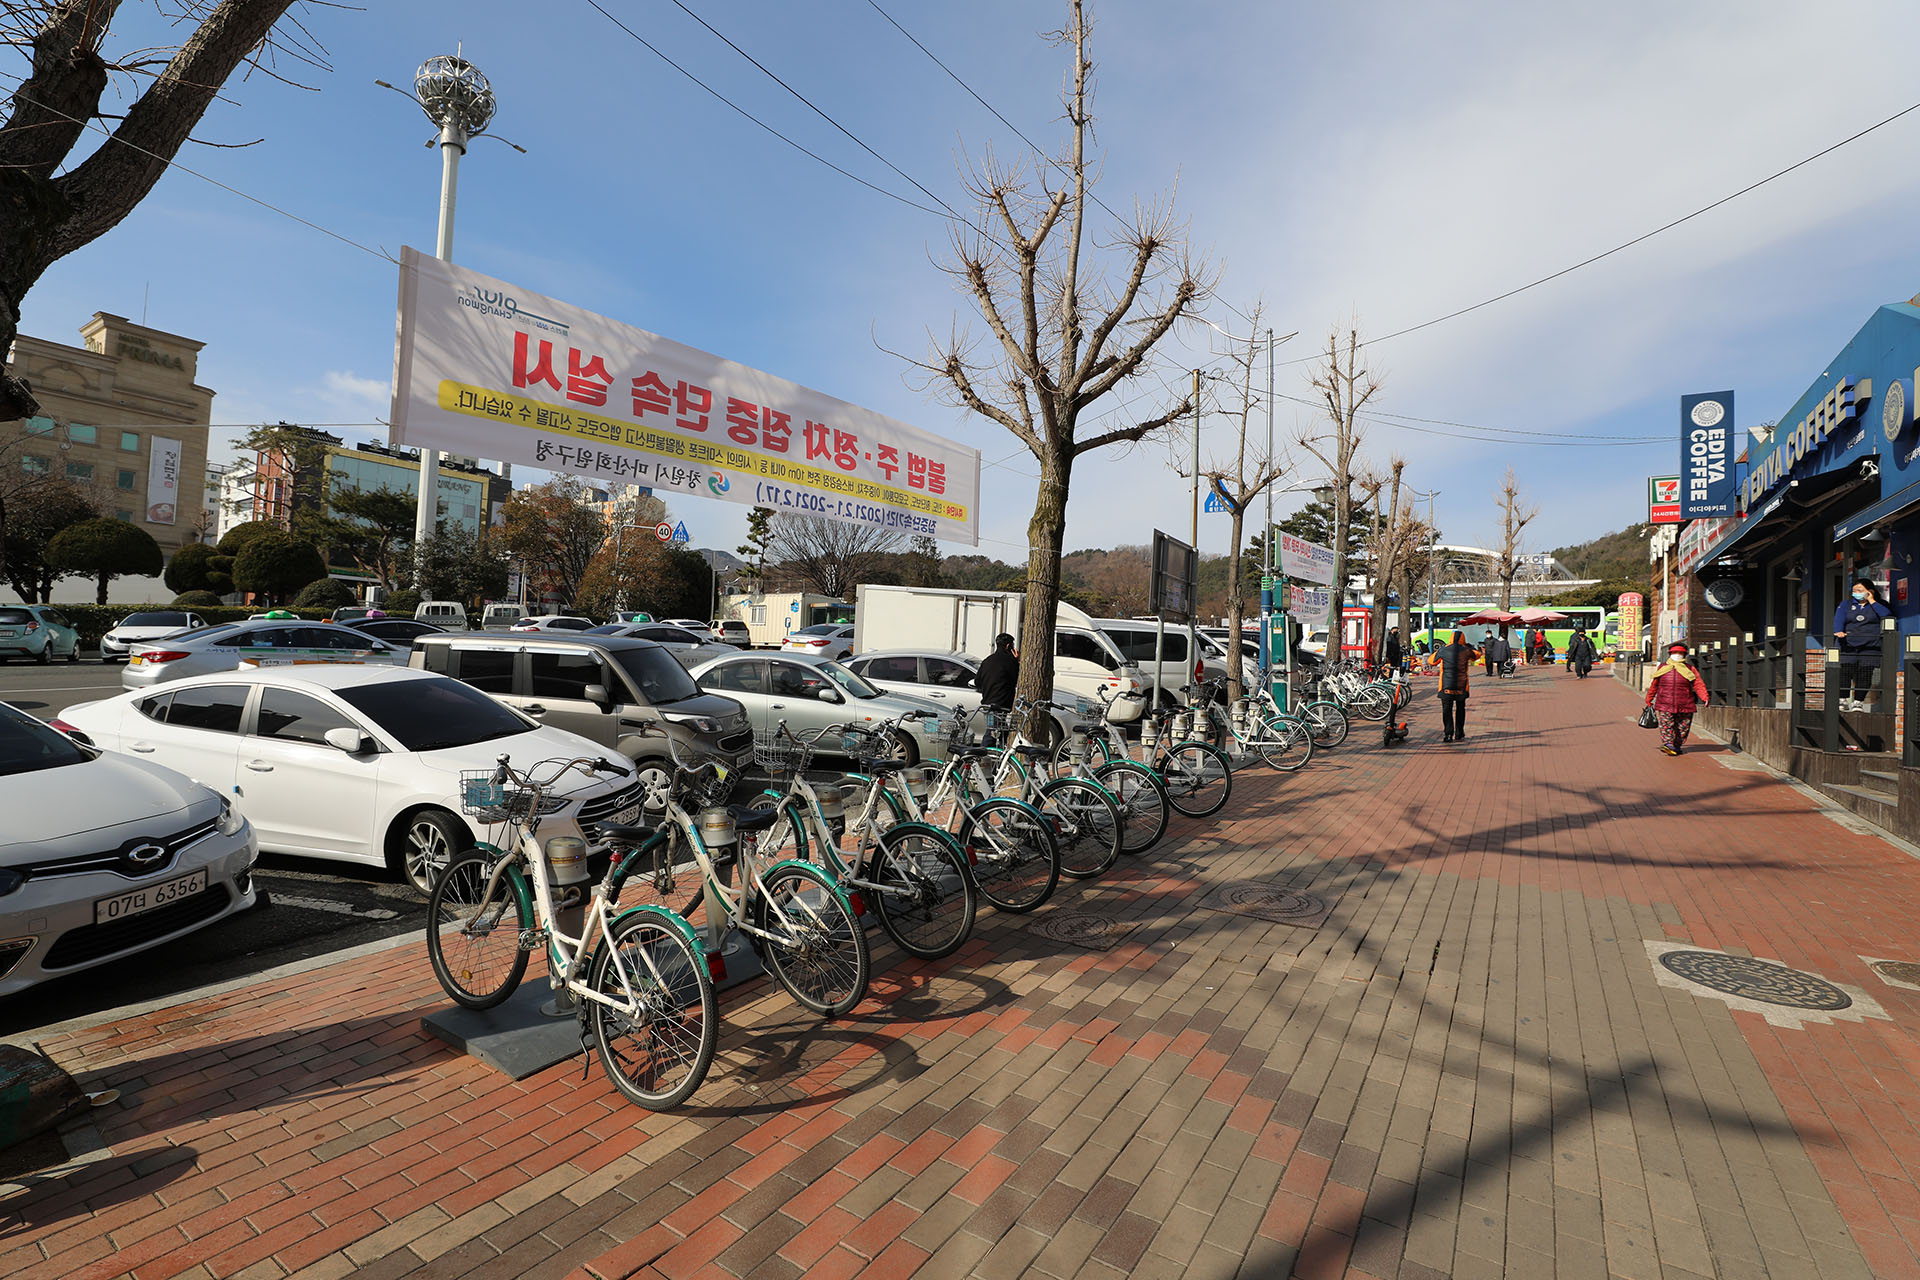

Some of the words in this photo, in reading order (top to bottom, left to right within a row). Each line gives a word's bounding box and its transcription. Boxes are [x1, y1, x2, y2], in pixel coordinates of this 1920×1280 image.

[1708, 428, 1726, 485] EDIYA
[1750, 445, 1785, 503] EDIYA
[1786, 376, 1853, 470] COFFEE
[1690, 429, 1708, 502] COFFEE
[659, 528, 669, 536] 40
[1625, 607, 1636, 650] 쇠고기국밥
[108, 893, 146, 917] 07더
[155, 877, 198, 903] 6356
